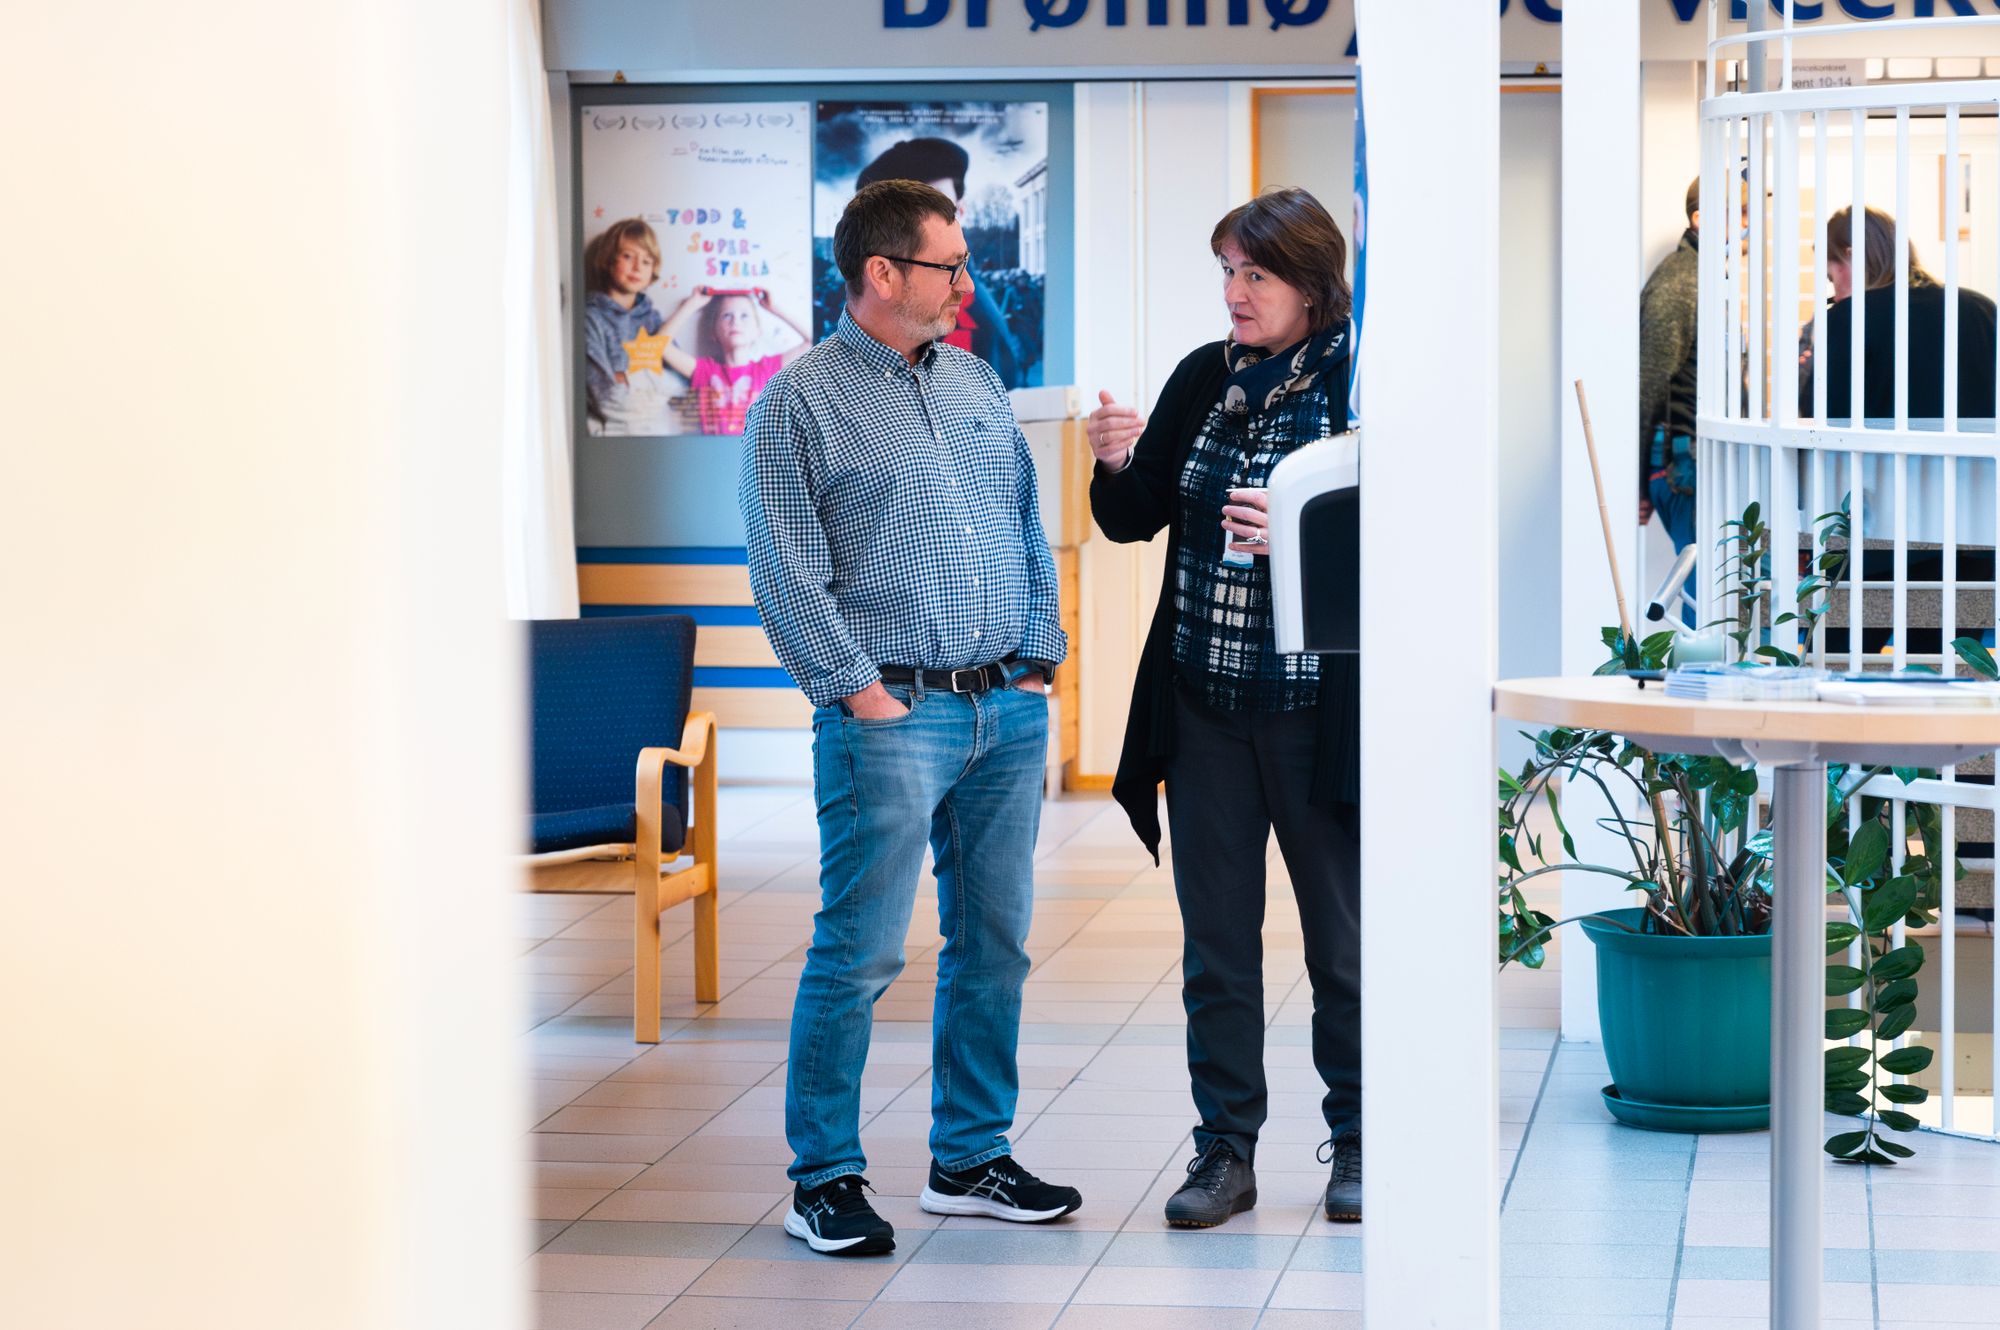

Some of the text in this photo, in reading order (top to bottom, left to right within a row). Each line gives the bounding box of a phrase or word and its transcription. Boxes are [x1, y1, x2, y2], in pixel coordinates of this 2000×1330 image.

[1818, 75, 1852, 89] 10-14
[666, 208, 721, 225] TODD
[733, 207, 746, 230] &
[706, 257, 770, 277] STELLA
